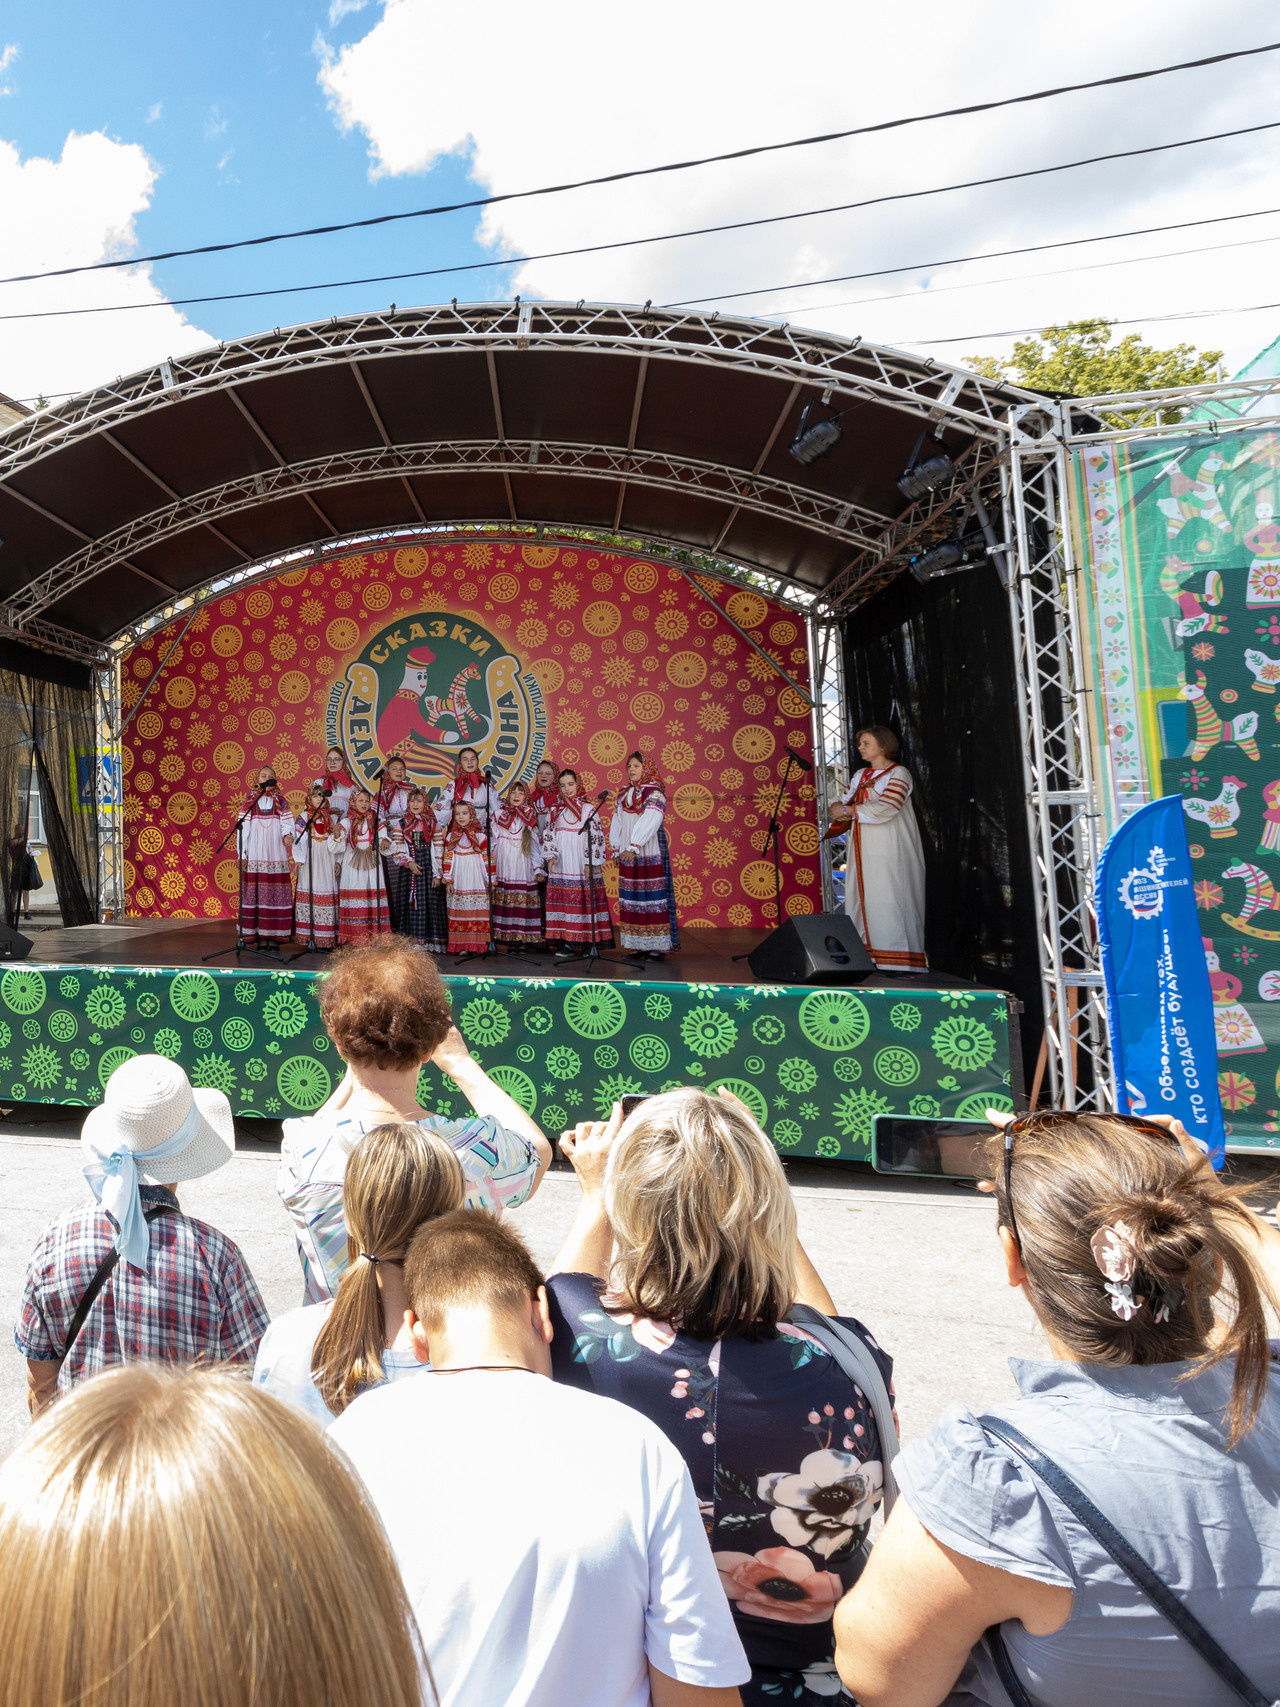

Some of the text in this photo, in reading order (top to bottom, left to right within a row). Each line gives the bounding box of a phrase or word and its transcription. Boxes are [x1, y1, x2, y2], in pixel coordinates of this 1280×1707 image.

[370, 620, 491, 664] СКАЗКИ
[326, 681, 345, 747] ОДОЕВСКИЙ
[349, 695, 381, 780] ДЕДА
[520, 673, 546, 784] ЛИНЯНОЙ ИГРУШКИ
[1171, 1017, 1200, 1089] создаёт
[1189, 1093, 1208, 1124] кто
